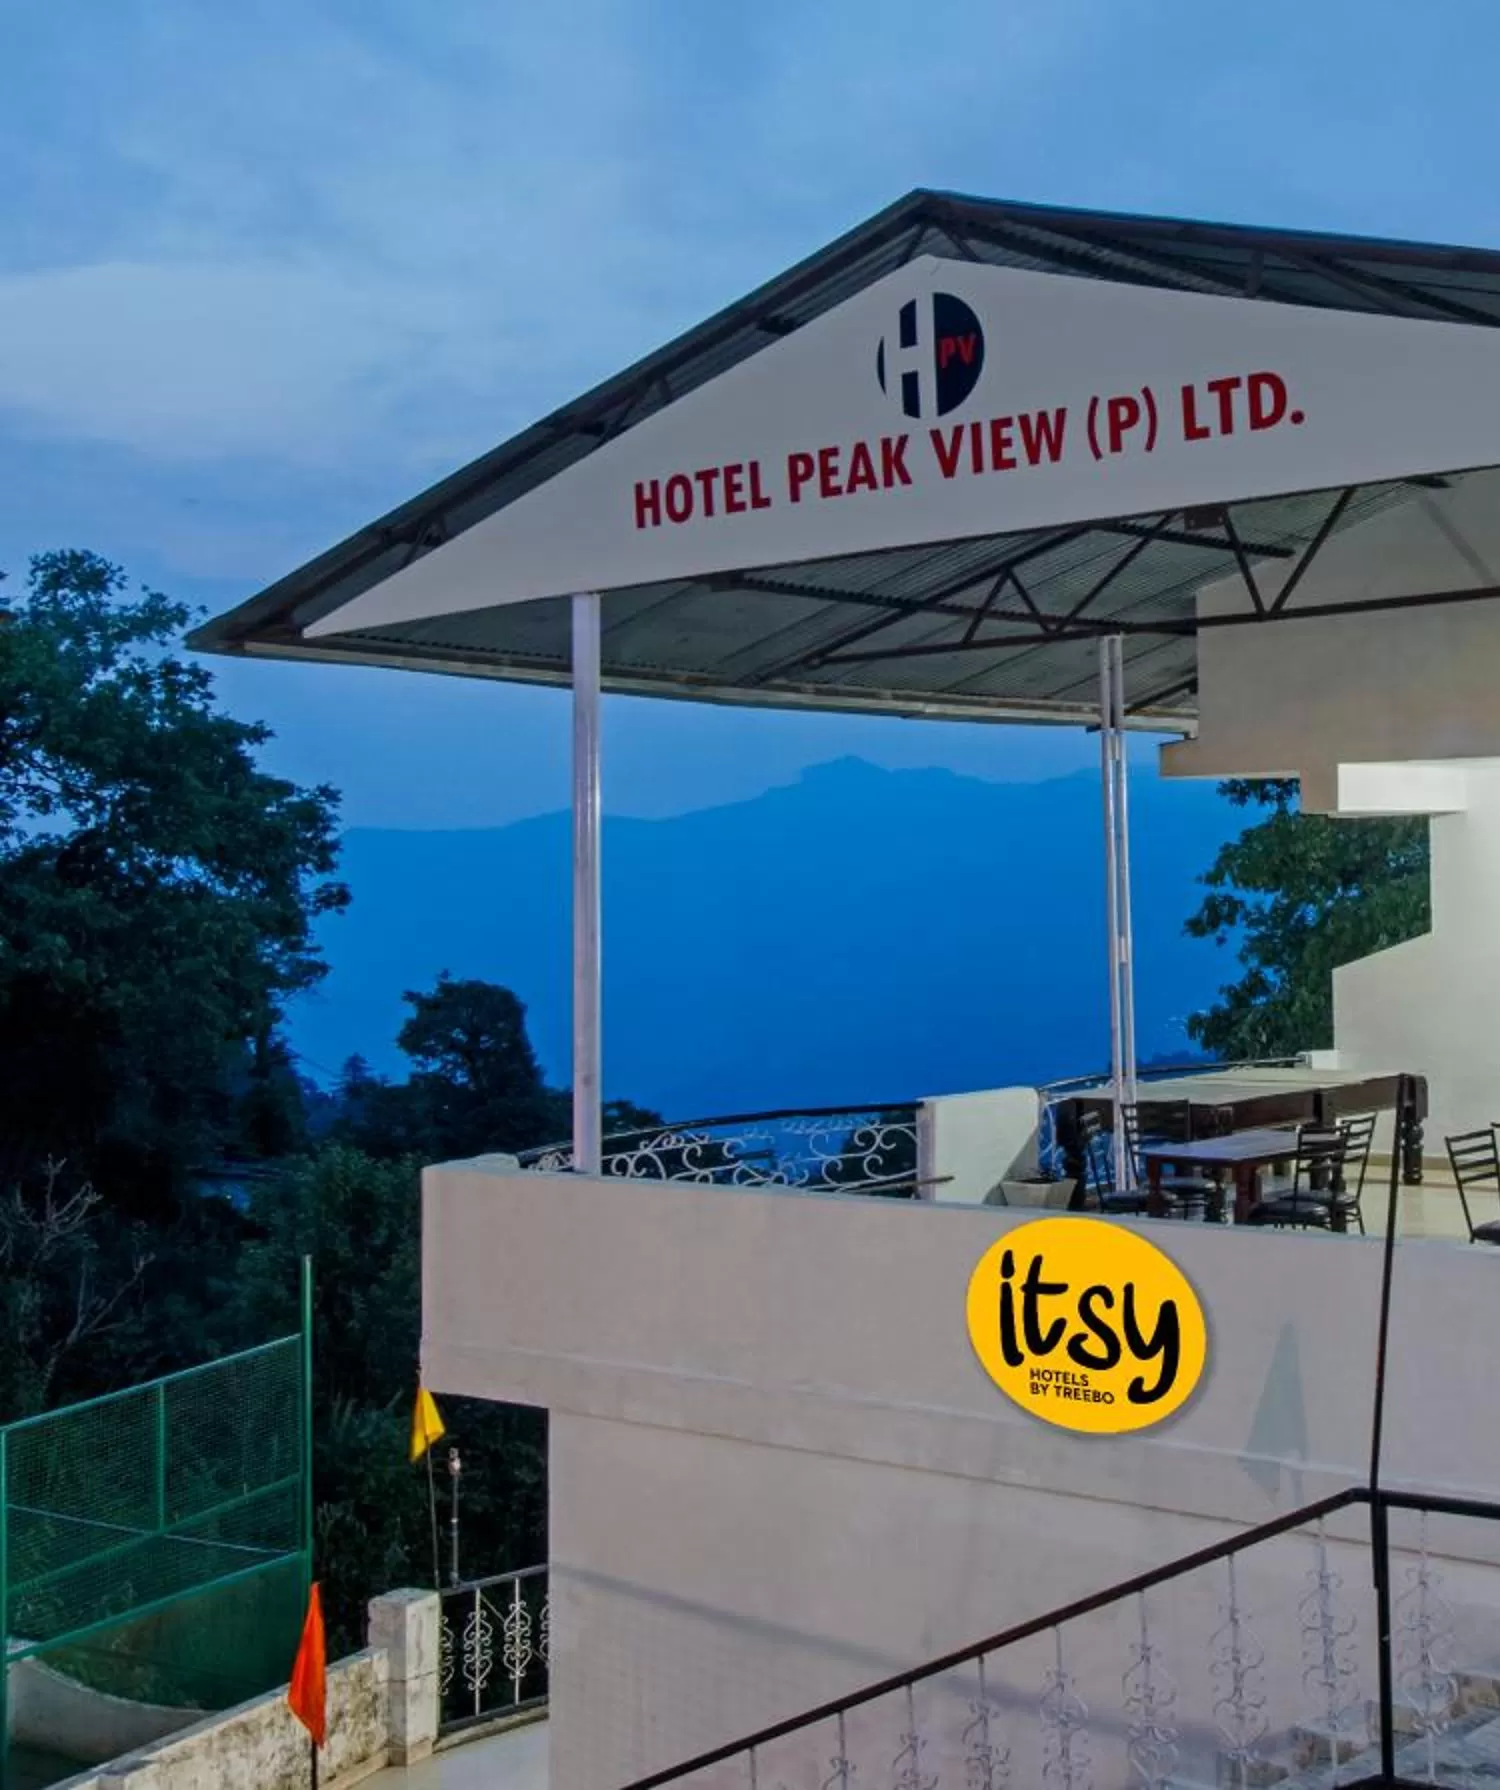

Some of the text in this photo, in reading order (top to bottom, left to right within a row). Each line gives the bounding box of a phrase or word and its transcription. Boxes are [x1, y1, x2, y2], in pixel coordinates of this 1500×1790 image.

[939, 333, 976, 369] PV
[634, 371, 1305, 529] HOTEL PEAK VIEW (P) LTD.
[1000, 1249, 1180, 1404] itsy
[1030, 1368, 1089, 1386] HOTELS
[1030, 1382, 1115, 1404] BY TREEBO
